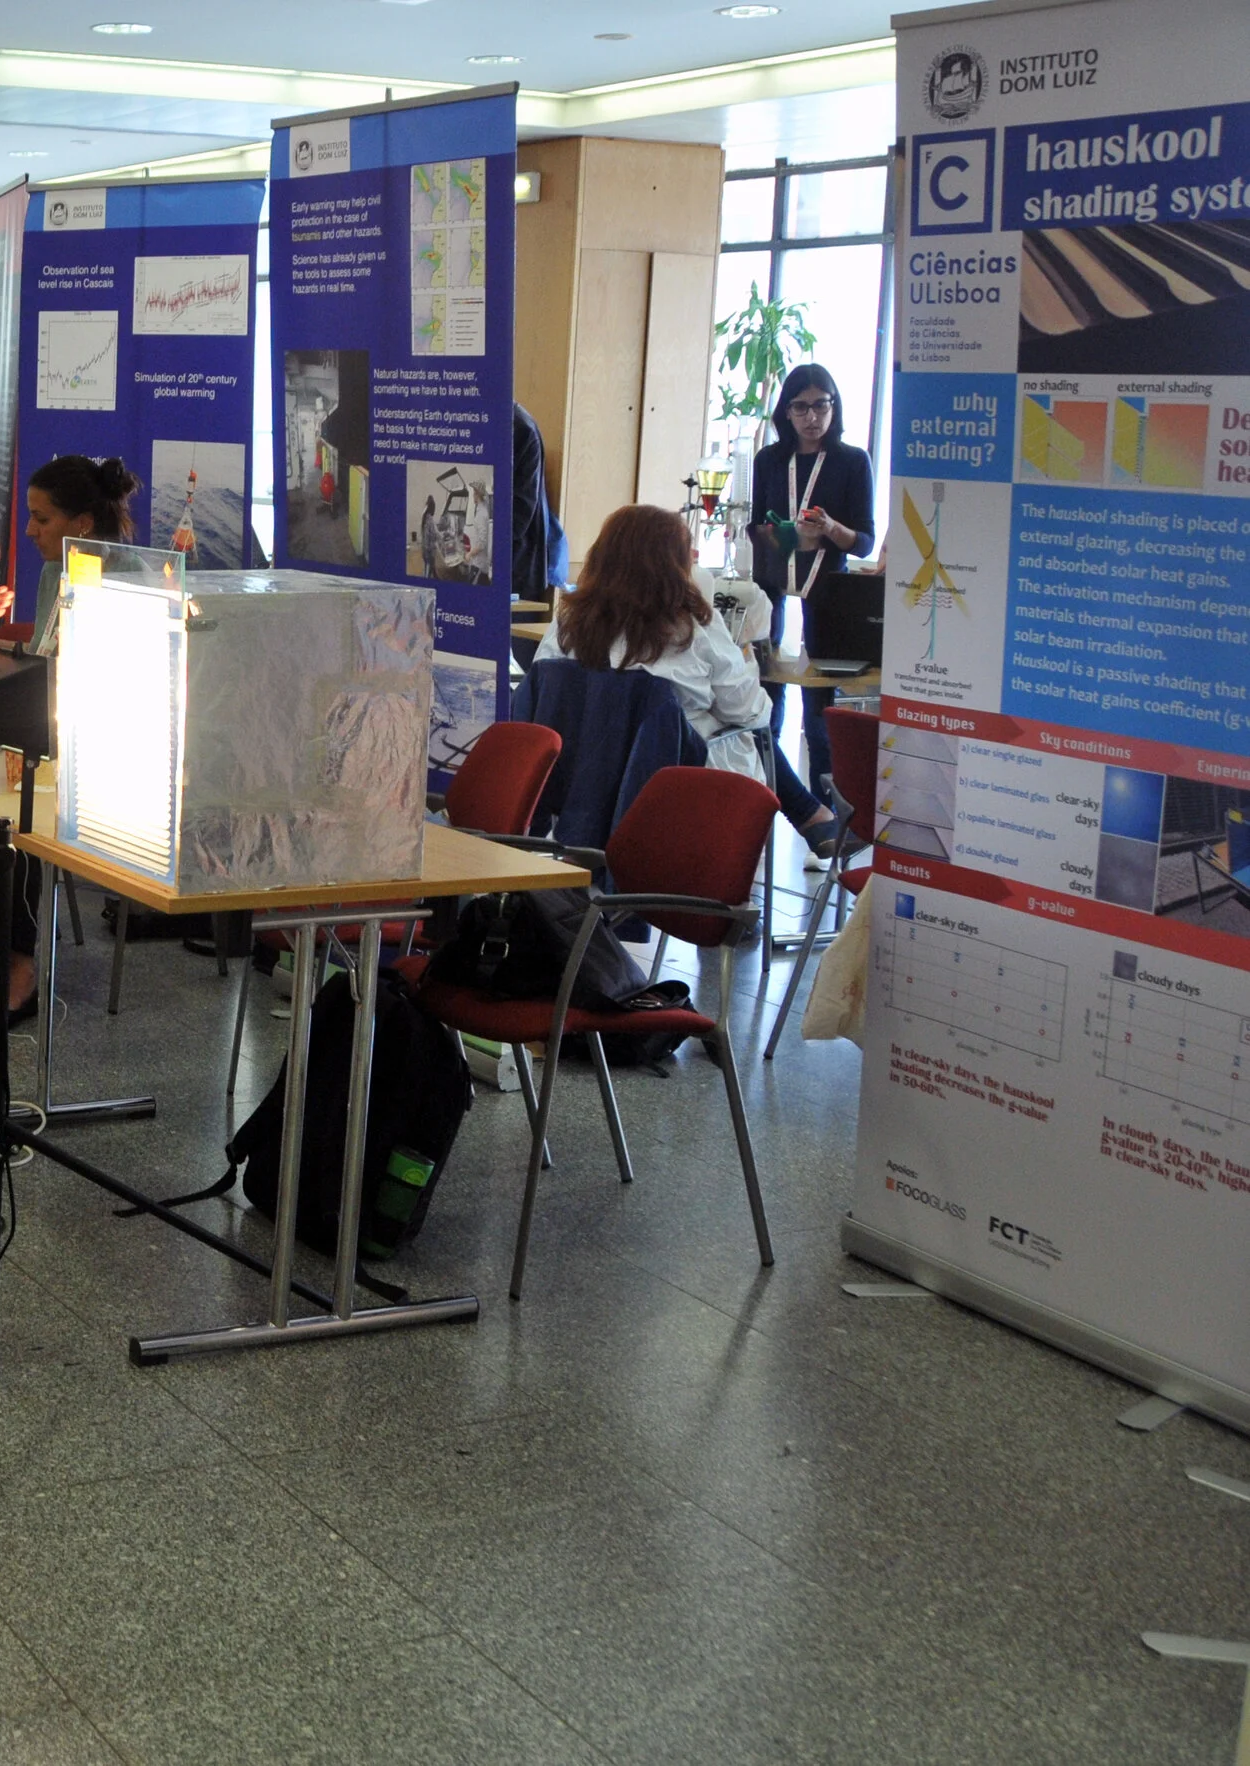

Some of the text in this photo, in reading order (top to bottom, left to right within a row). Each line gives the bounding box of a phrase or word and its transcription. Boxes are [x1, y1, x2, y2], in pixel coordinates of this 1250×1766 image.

[1000, 48, 1098, 75] INSTITUTO
[1000, 69, 1097, 94] DOM LUIZ
[318, 141, 348, 152] INSTITUTO
[1027, 116, 1222, 172] hauskool
[318, 150, 347, 160] DOM LUIZ
[292, 194, 381, 213] Early warning may help civil
[1023, 184, 1158, 222] shading
[292, 213, 359, 229] protection the case
[292, 225, 382, 242] tsunamis and other hazards.
[292, 251, 376, 265] Science has already given
[909, 250, 1017, 276] Ciências
[43, 265, 114, 276] Observation of sea
[292, 267, 371, 279] the tools assess some
[38, 278, 114, 289] level rise Cascais
[292, 282, 356, 294] hazards real time.
[910, 281, 1000, 304] ULisboa
[922, 353, 950, 362] Lisboa
[134, 372, 176, 383] Simulation
[178, 373, 187, 383] of
[206, 375, 237, 387] century
[374, 368, 477, 381] Natural hazards however,
[154, 387, 215, 400] global warming
[374, 384, 480, 397] something have live with.
[1024, 380, 1079, 394] no shading
[1117, 381, 1213, 397] external shading
[953, 392, 997, 417] why
[374, 408, 479, 423] Understanding Earth dynamics
[374, 422, 470, 437] the basis decision we
[911, 416, 996, 437] external
[374, 439, 473, 454] need make many places
[906, 440, 995, 467] shading?
[374, 454, 406, 464] our world.
[1021, 503, 1238, 536] The hauskool shading is placed
[1020, 531, 1245, 563] external glazing, decreasing the
[1019, 554, 1231, 588] and absorbed solar heat gains.
[1018, 578, 1196, 610] The activation mechanism
[436, 608, 475, 626] Francesa
[1016, 605, 1248, 644] materials thermal expansion that
[1014, 628, 1167, 661] solar beam irradiation.
[915, 662, 949, 675] g-value
[1013, 652, 1246, 699] Hauskool is passive shading that
[1012, 677, 1221, 722] the solar heat gains coefficient
[897, 707, 975, 731] Glazing types
[1040, 732, 1131, 759] Sky conditions
[1055, 792, 1099, 811] clear-sky
[1075, 813, 1099, 828] days
[890, 860, 931, 880] Results
[1060, 861, 1094, 879] cloudy
[1069, 880, 1092, 895] days
[1028, 897, 1076, 917] g-value
[916, 910, 979, 935] clear-sky days
[1138, 970, 1200, 997] cloudy days
[904, 1049, 951, 1072] clear-sky
[984, 1075, 1000, 1090] the
[1003, 1081, 1055, 1110] hauskool
[890, 1059, 1048, 1122] shading decreases the g-value
[1101, 1132, 1144, 1156] g-value
[1119, 1121, 1159, 1144] cloudy
[1201, 1149, 1221, 1167] the
[1116, 1153, 1171, 1180] clear-sky
[896, 1181, 967, 1220] FOCOGLASS
[989, 1216, 1029, 1245] FCT
